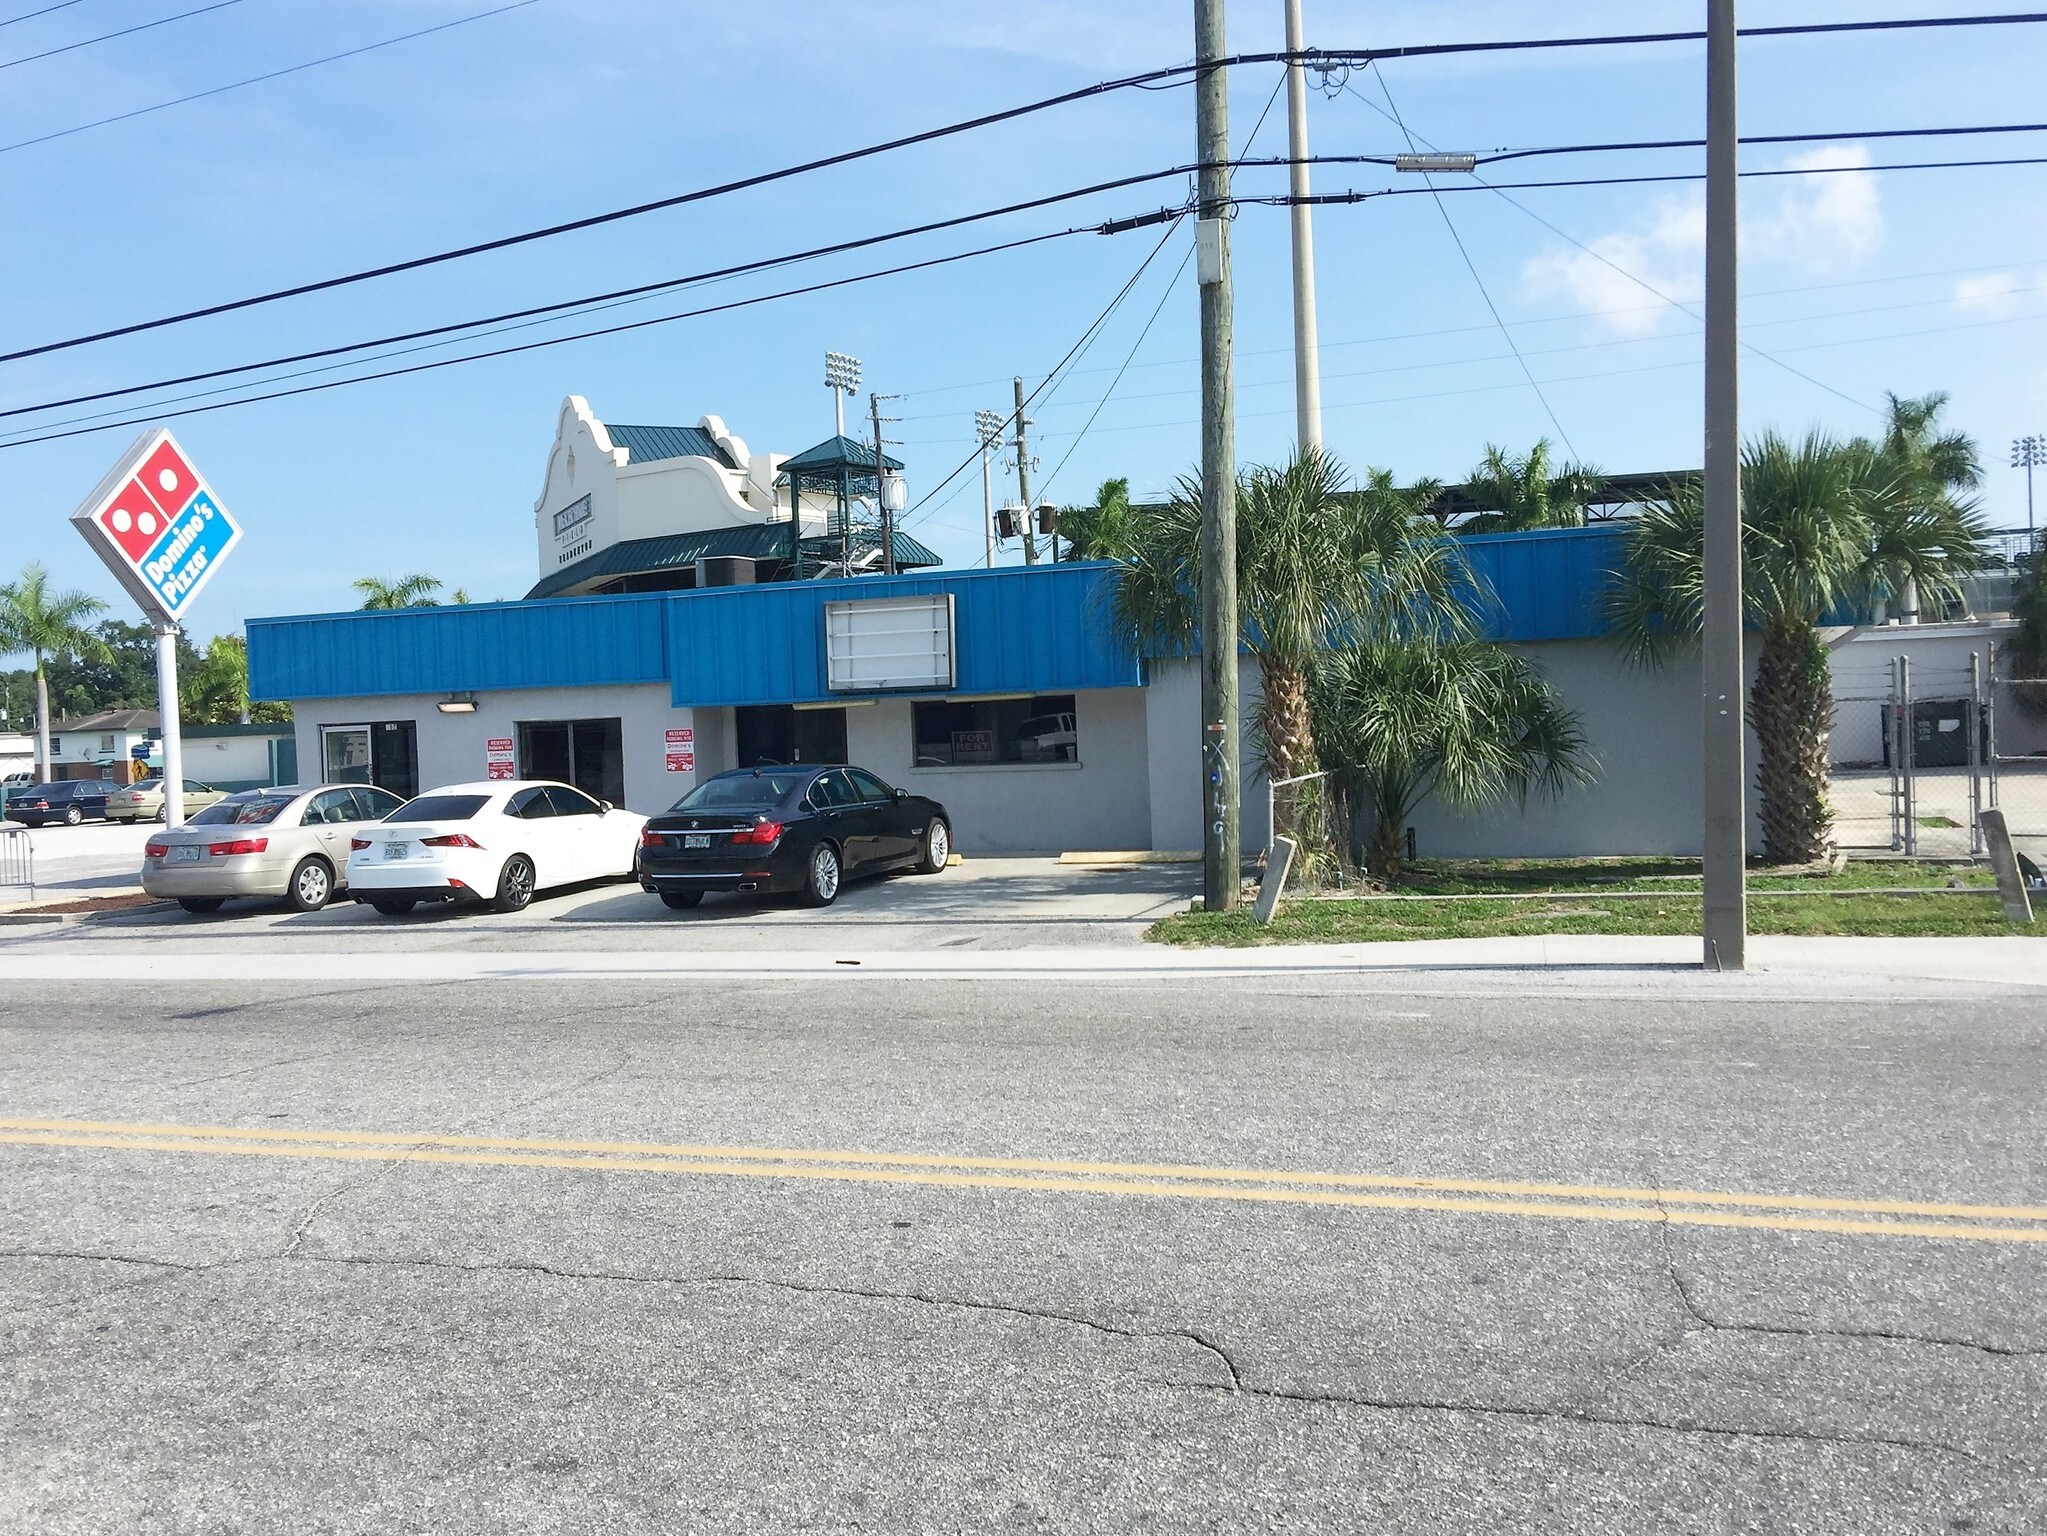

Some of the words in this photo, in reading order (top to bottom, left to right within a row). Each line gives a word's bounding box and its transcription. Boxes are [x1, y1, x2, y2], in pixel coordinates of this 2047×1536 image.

[145, 502, 214, 586] Domino's
[161, 549, 208, 606] Pizza
[956, 742, 989, 751] RENT
[960, 733, 984, 743] FOR
